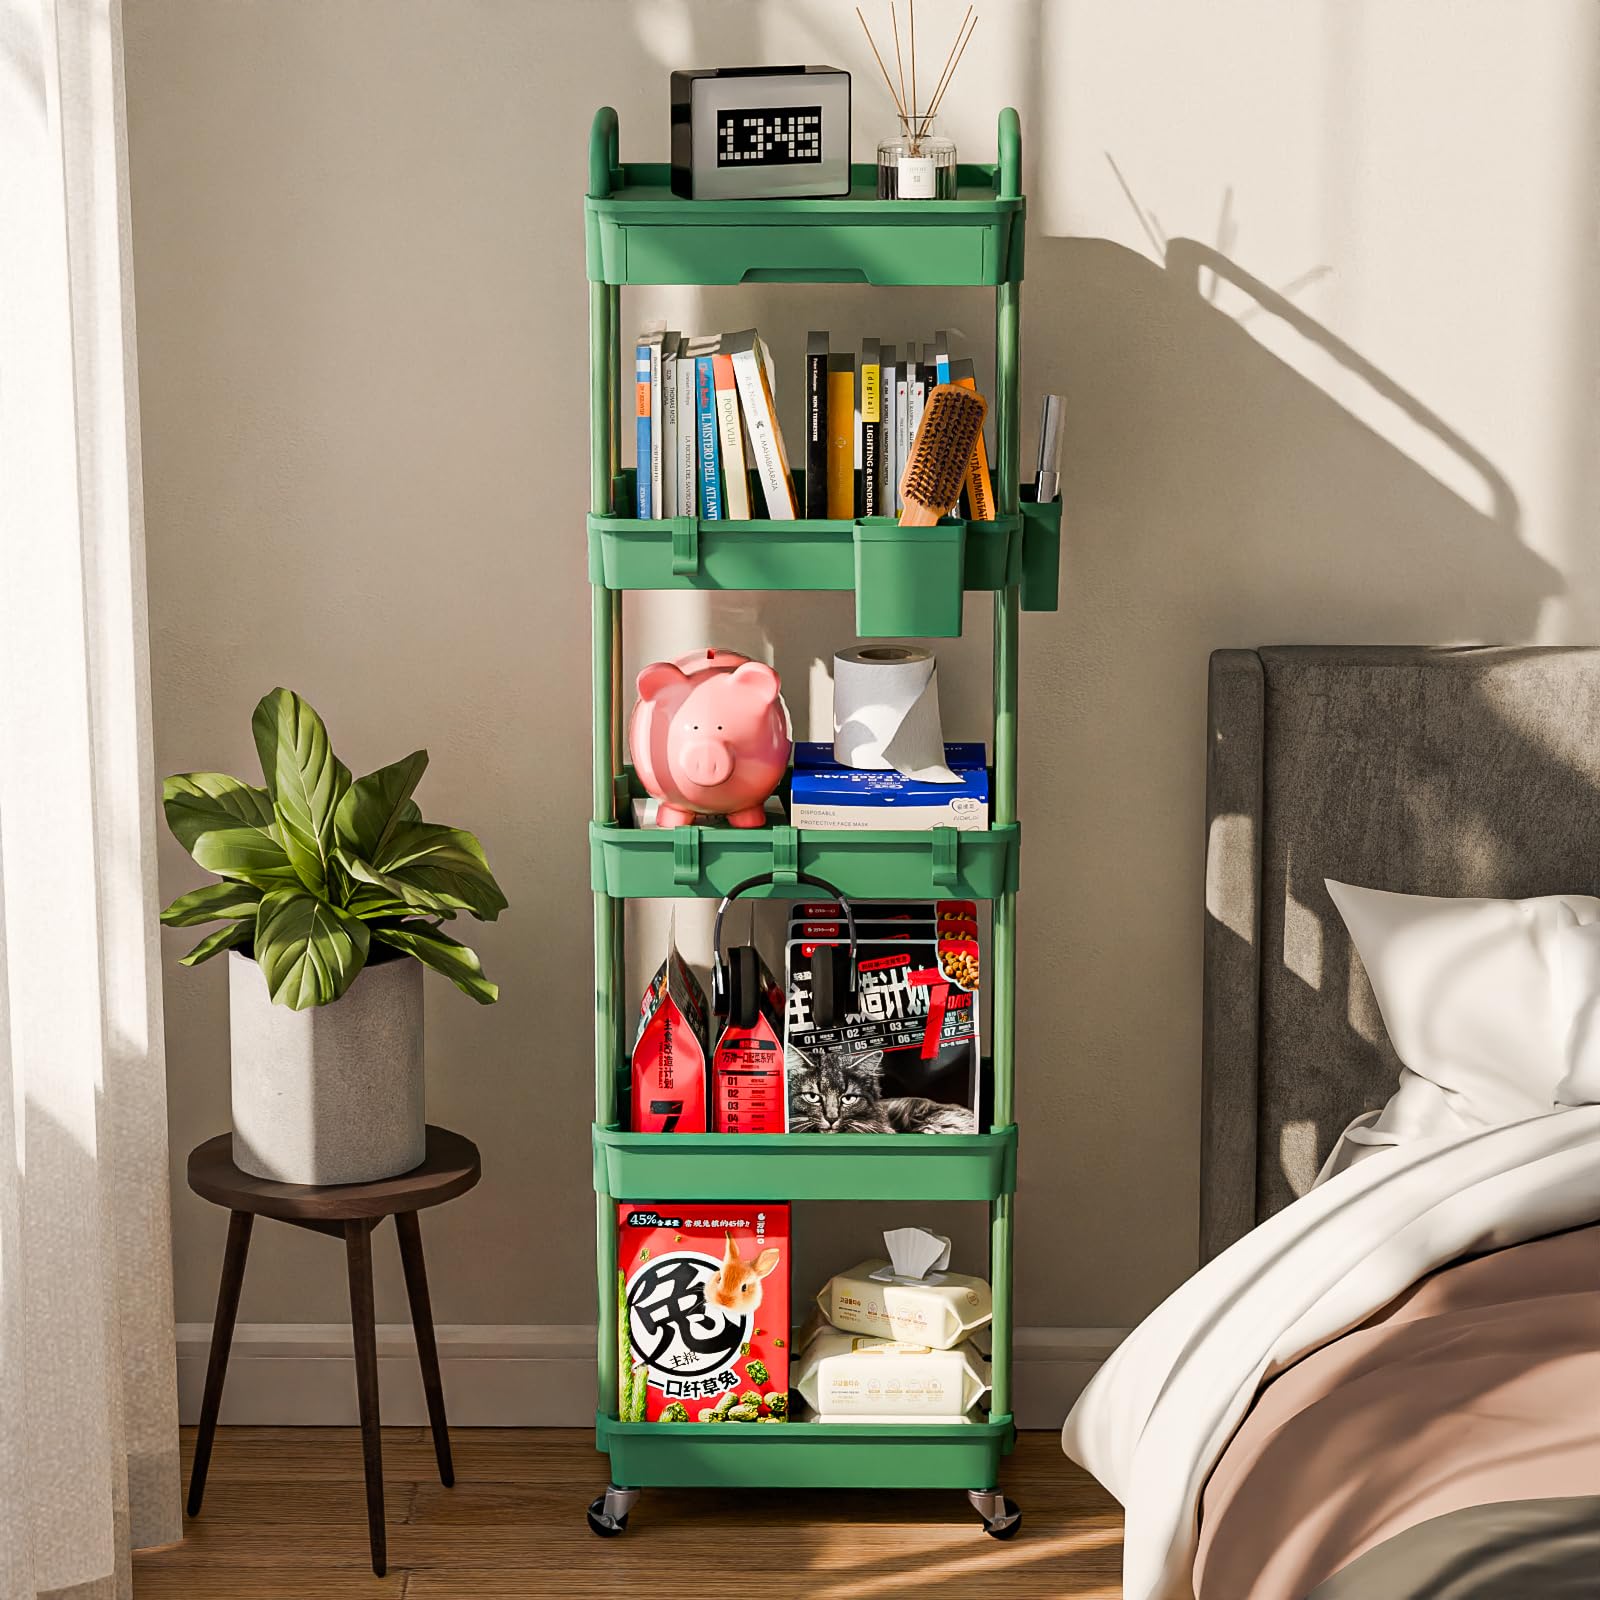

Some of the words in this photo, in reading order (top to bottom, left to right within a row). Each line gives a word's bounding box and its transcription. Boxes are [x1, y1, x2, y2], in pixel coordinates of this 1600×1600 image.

[719, 116, 819, 161] 13:45
[701, 413, 712, 422] IL
[722, 398, 733, 427] POPOL
[702, 422, 713, 460] MISTERO
[726, 428, 736, 446] VUH
[866, 424, 874, 467] LIGHTING
[704, 462, 716, 484] DELL'
[947, 994, 972, 1010] DAYS
[890, 1022, 902, 1032] 03
[944, 1028, 956, 1036] 07
[846, 1028, 860, 1038] 02
[804, 1036, 816, 1045] 01
[898, 1034, 910, 1044] 06
[855, 1041, 868, 1050] 05
[663, 1018, 674, 1089] 主食改造计划
[728, 1077, 738, 1086] 01
[728, 1089, 739, 1098] 02
[728, 1102, 738, 1110] 03
[728, 1114, 738, 1123] 04
[669, 1352, 699, 1369] 主粮
[647, 1371, 740, 1398] 一口纤草兔
